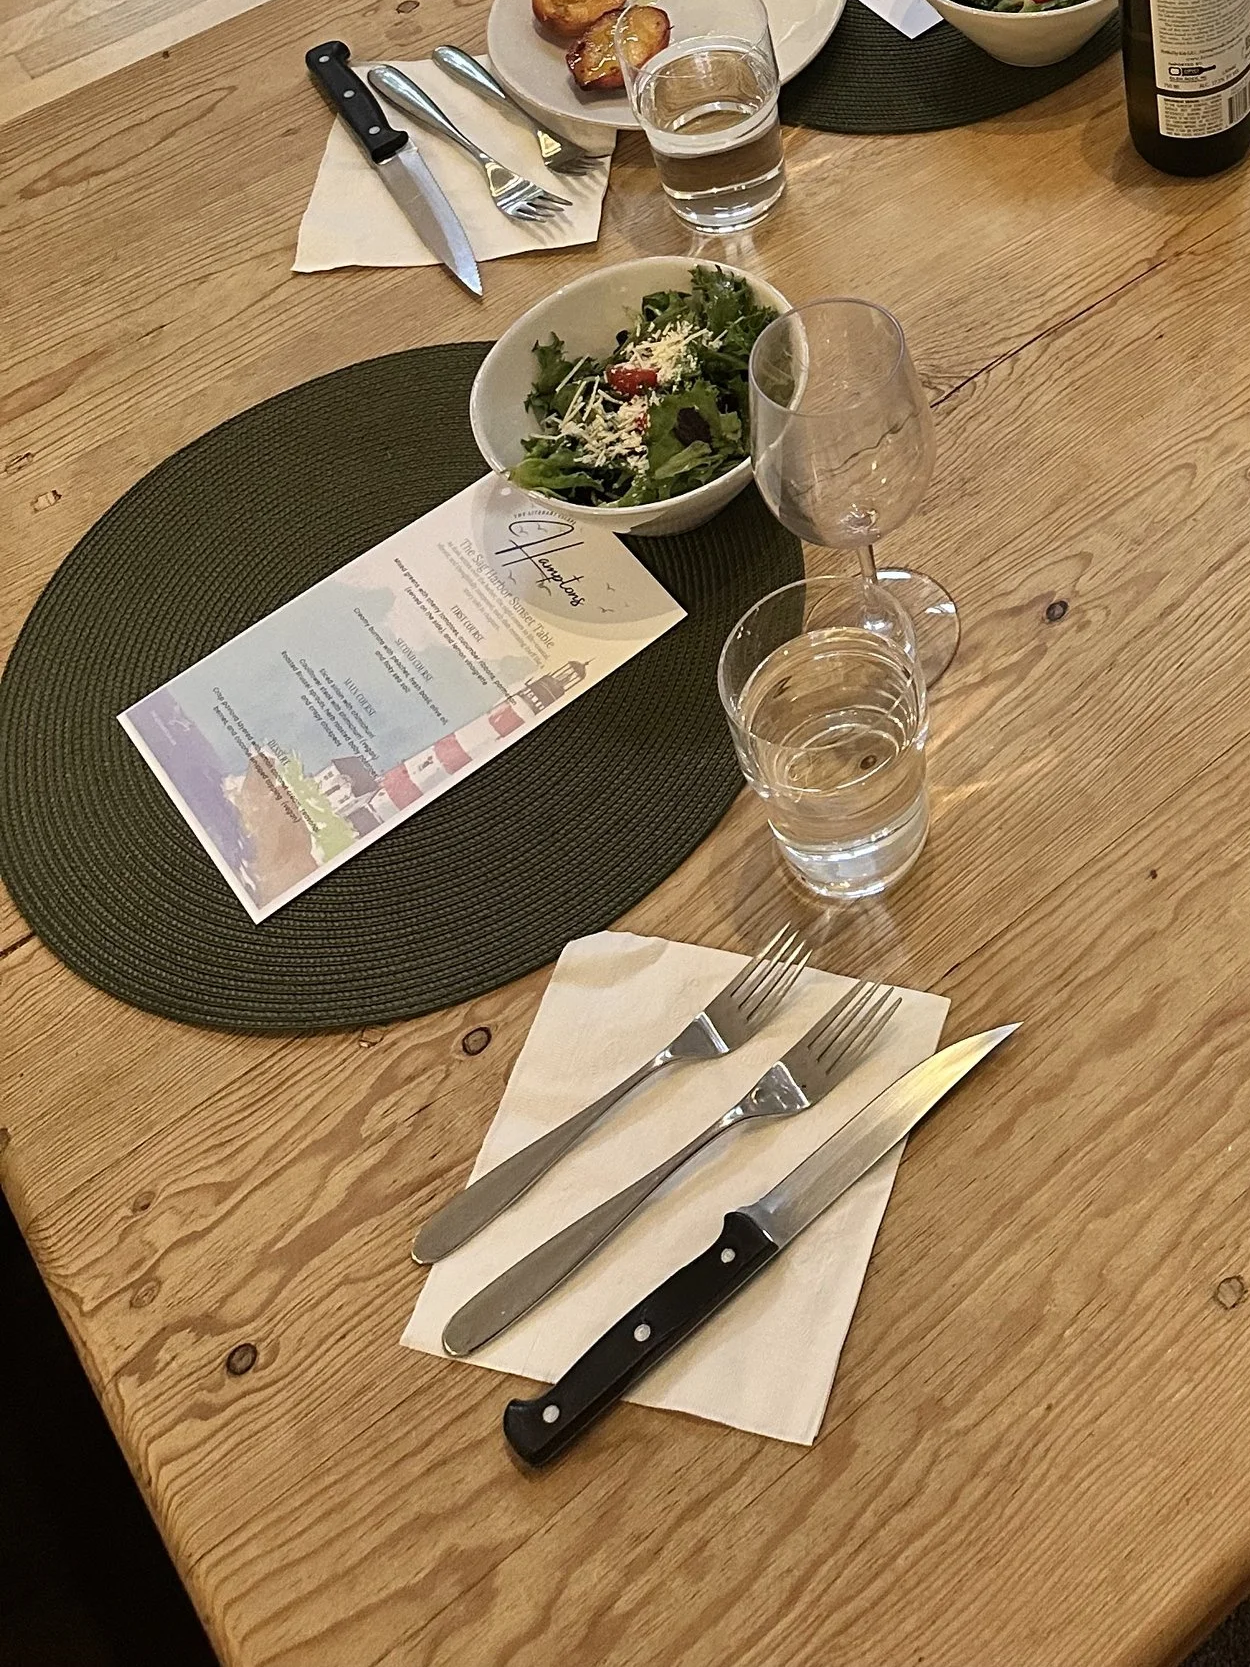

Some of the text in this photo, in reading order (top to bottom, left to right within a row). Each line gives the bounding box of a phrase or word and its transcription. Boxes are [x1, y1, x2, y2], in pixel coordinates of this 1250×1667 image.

[456, 537, 478, 558] The
[469, 553, 491, 573] Sag
[482, 567, 515, 601] Harbor
[506, 595, 539, 629] Sunset
[529, 622, 557, 650] Table
[494, 520, 584, 606] Hamptons
